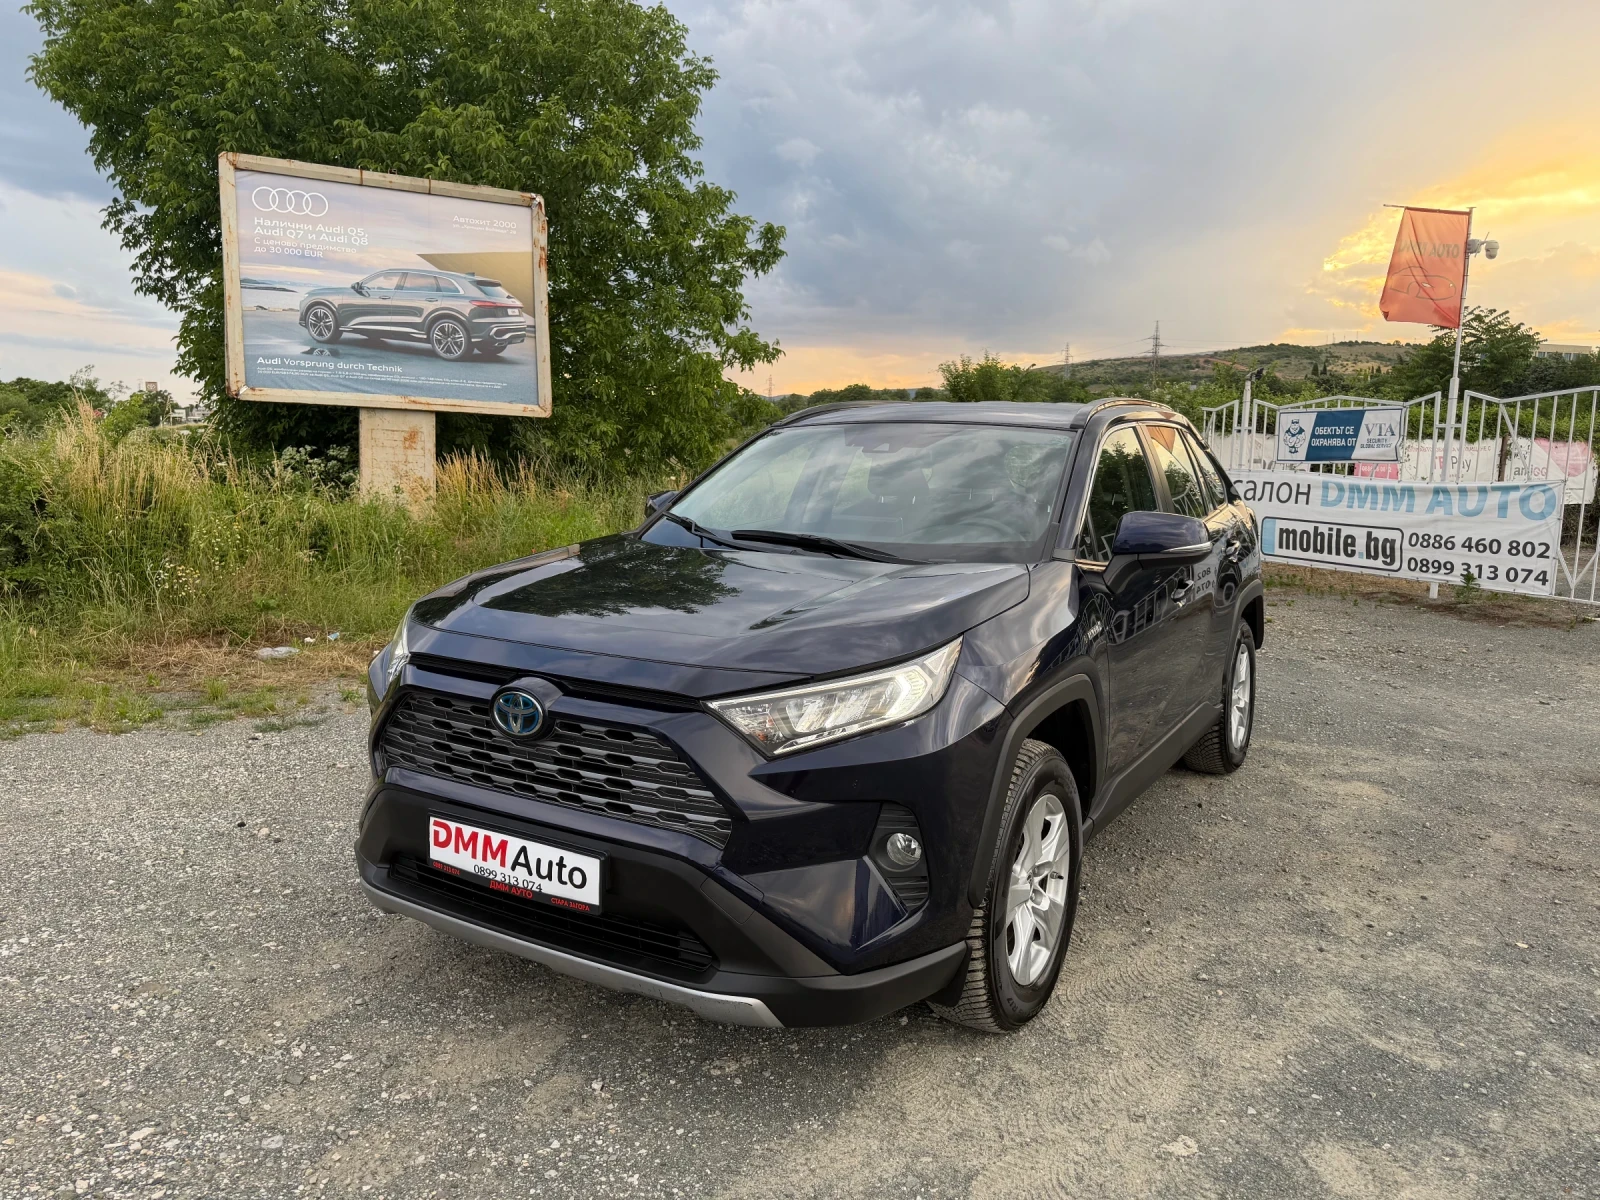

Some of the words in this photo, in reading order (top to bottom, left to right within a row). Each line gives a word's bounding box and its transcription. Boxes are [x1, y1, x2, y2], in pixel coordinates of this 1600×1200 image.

[254, 217, 312, 230] Налични
[316, 224, 344, 234] Audi
[348, 227, 368, 238] Q5,
[494, 220, 516, 228] 2000
[254, 226, 284, 236] Audi
[286, 230, 304, 239] Q7
[320, 234, 348, 244] Audi
[351, 237, 368, 246] Q8
[263, 239, 298, 248] ценово
[300, 242, 357, 254] предимство
[269, 246, 282, 254] 30
[304, 250, 324, 258] EUR
[1428, 242, 1460, 258] AUTO
[257, 356, 281, 365] Audi
[283, 358, 335, 370] Vorsprung
[337, 361, 364, 370] durch
[366, 363, 403, 373] Technik
[1314, 426, 1344, 435] ОБЕКТЪТ
[1345, 426, 1354, 434] СЕ
[1364, 422, 1396, 436] VTA
[1311, 438, 1346, 447] ОХРАНЯВА
[1347, 438, 1356, 446] ОТ
[1320, 479, 1416, 513] DMM
[1426, 483, 1557, 521] AUTO
[1278, 526, 1396, 567] mobile.bg
[1408, 532, 1456, 551] 0886
[1461, 536, 1502, 556] 460
[1507, 540, 1551, 560] 802
[1407, 556, 1455, 576] 0899
[1460, 562, 1499, 581] 313
[1505, 566, 1549, 586] 074
[474, 864, 497, 879] 0899
[500, 873, 519, 886] 313
[522, 879, 542, 892] 074
[490, 880, 509, 892] ДММ
[512, 888, 533, 899] АУТО
[550, 898, 568, 906] СТАРА
[569, 902, 590, 912] ЗАГОРА
